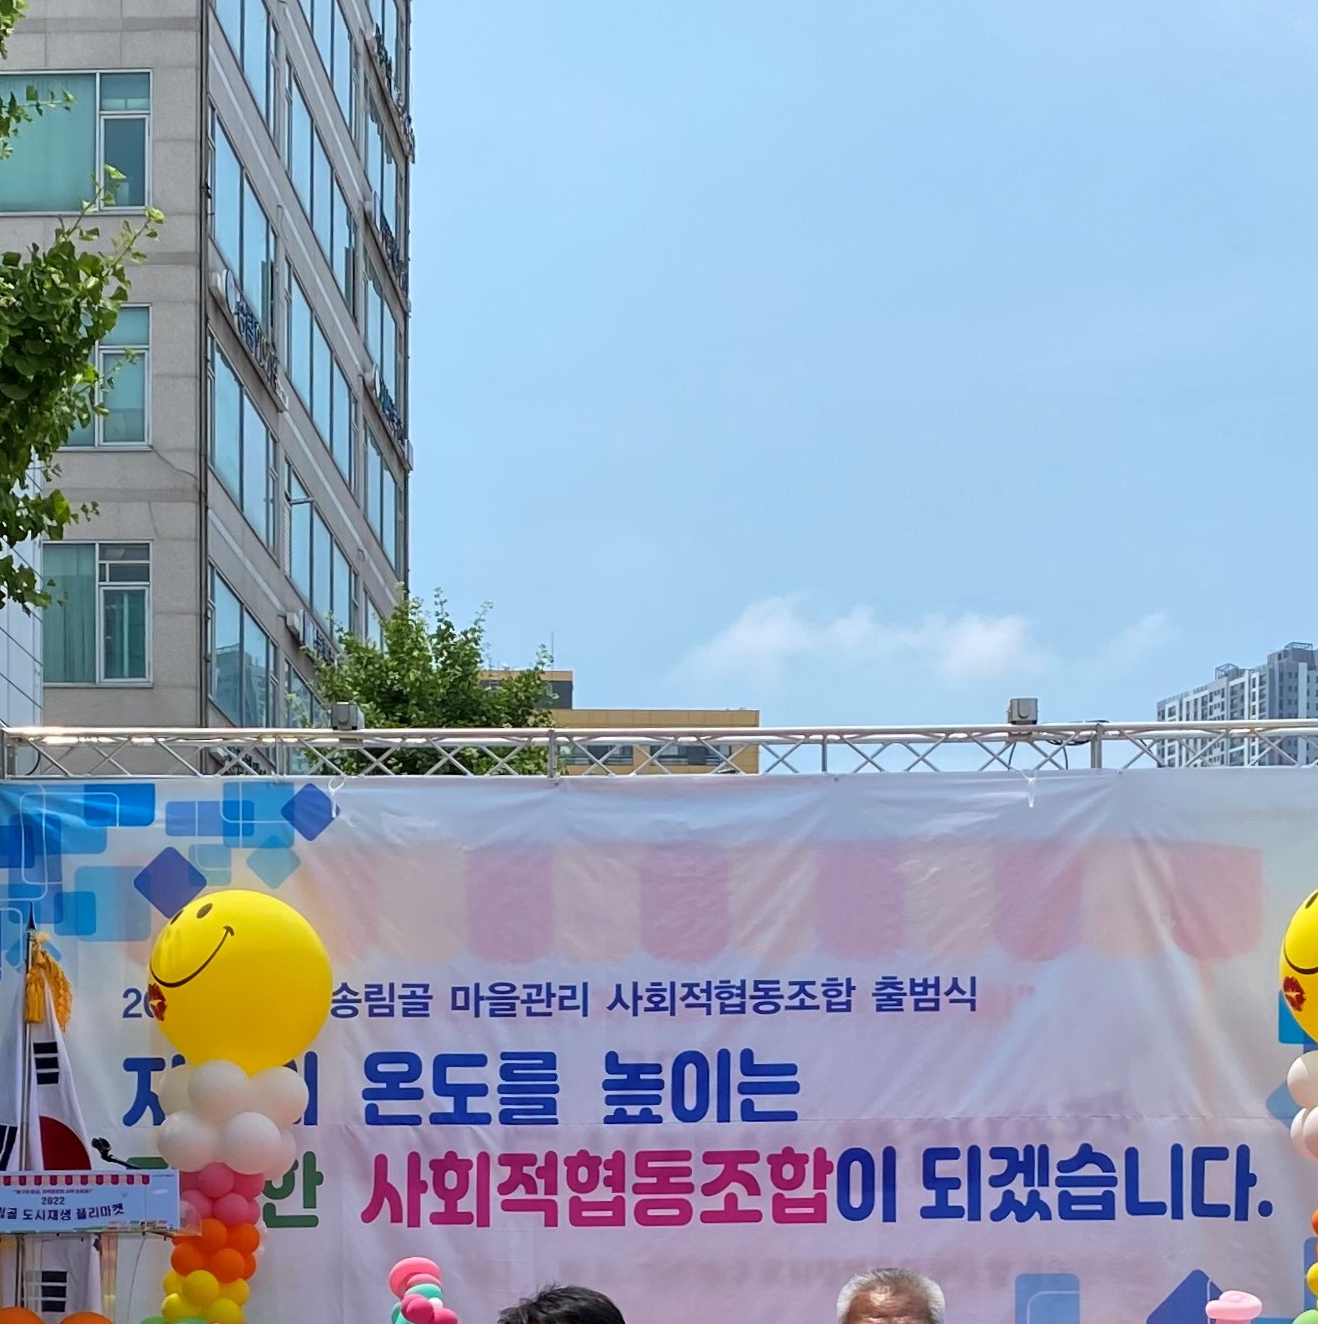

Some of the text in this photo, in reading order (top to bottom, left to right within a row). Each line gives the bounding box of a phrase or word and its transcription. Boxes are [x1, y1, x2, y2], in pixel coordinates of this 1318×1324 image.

[331, 975, 977, 1019] 송림골 마을관리 사회적협동조합 출범식
[361, 1051, 560, 1126] 온도를
[601, 1047, 801, 1125] 높이는
[41, 1196, 66, 1206] 2022
[360, 1145, 897, 1228] 사회적협동조합이
[919, 1142, 1273, 1223] 되겠습니다.
[22, 1207, 72, 1221] 도시재생
[77, 1202, 125, 1220] 플리마켓
